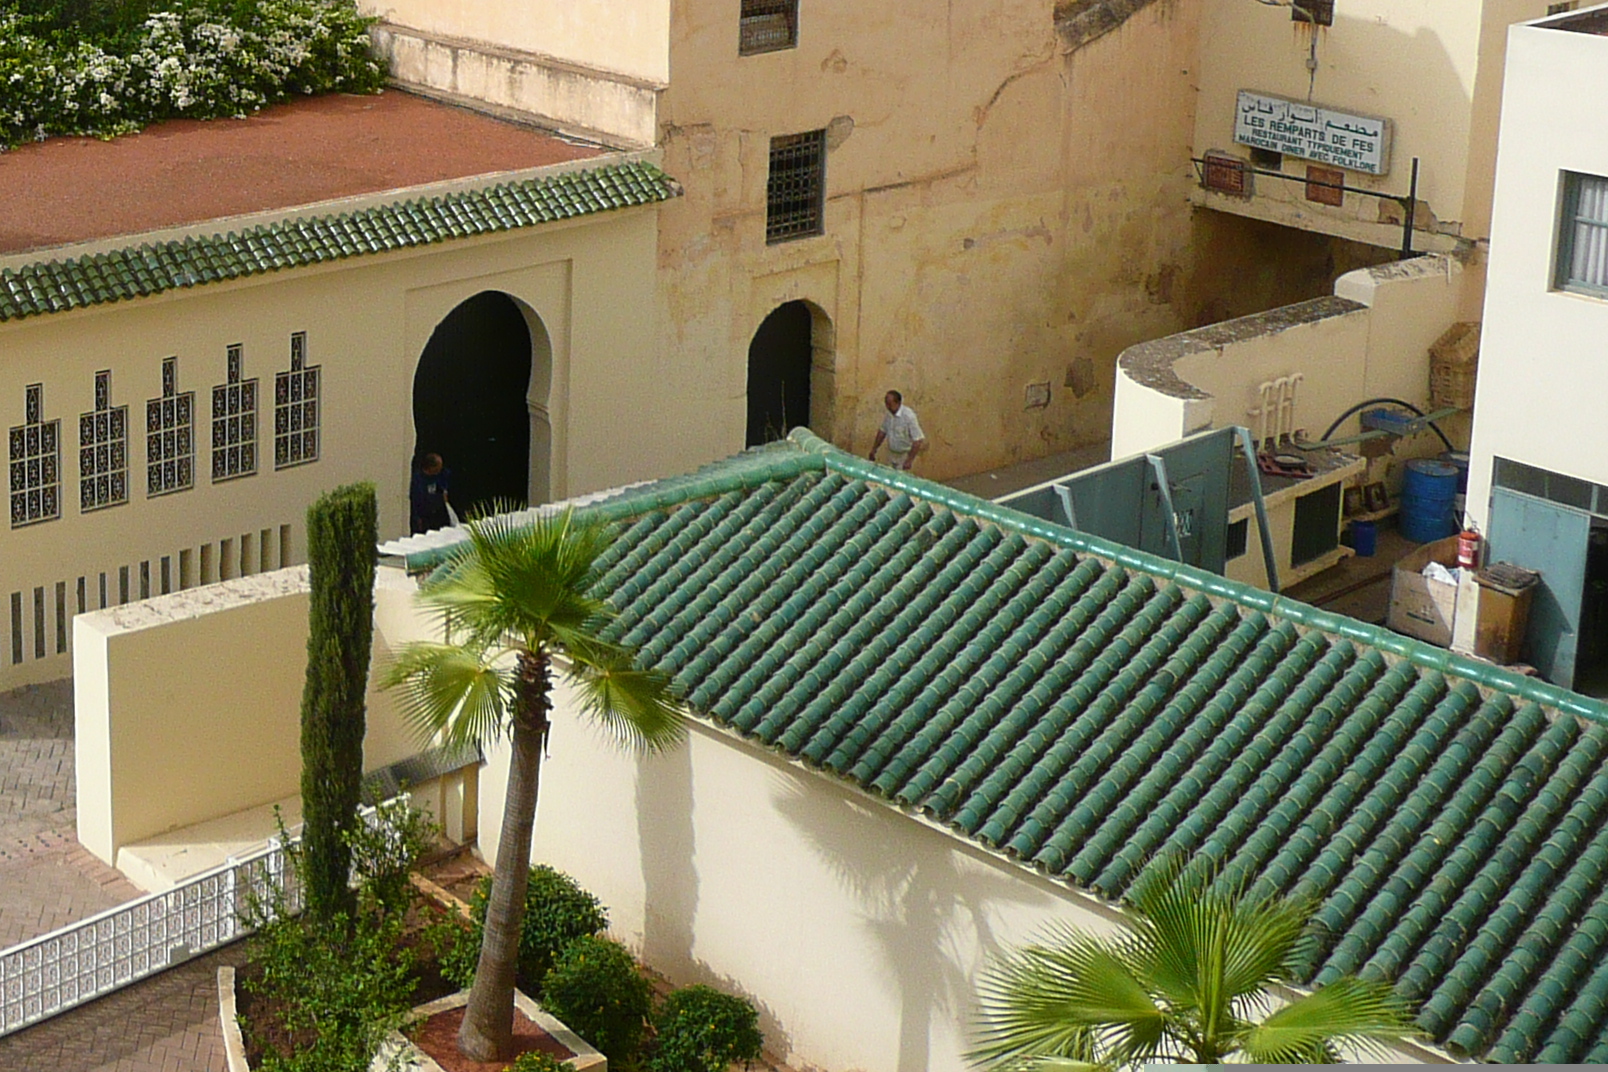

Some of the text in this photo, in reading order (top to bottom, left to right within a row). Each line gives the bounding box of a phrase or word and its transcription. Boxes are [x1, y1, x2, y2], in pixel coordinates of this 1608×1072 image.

[1238, 133, 1377, 173] MAROCAIN DINER AVEC FOLKLORE
[1244, 114, 1374, 154] LES REMPARTS DE FES
[1252, 128, 1363, 161] RESTAURANT TYPIQUEMENT
